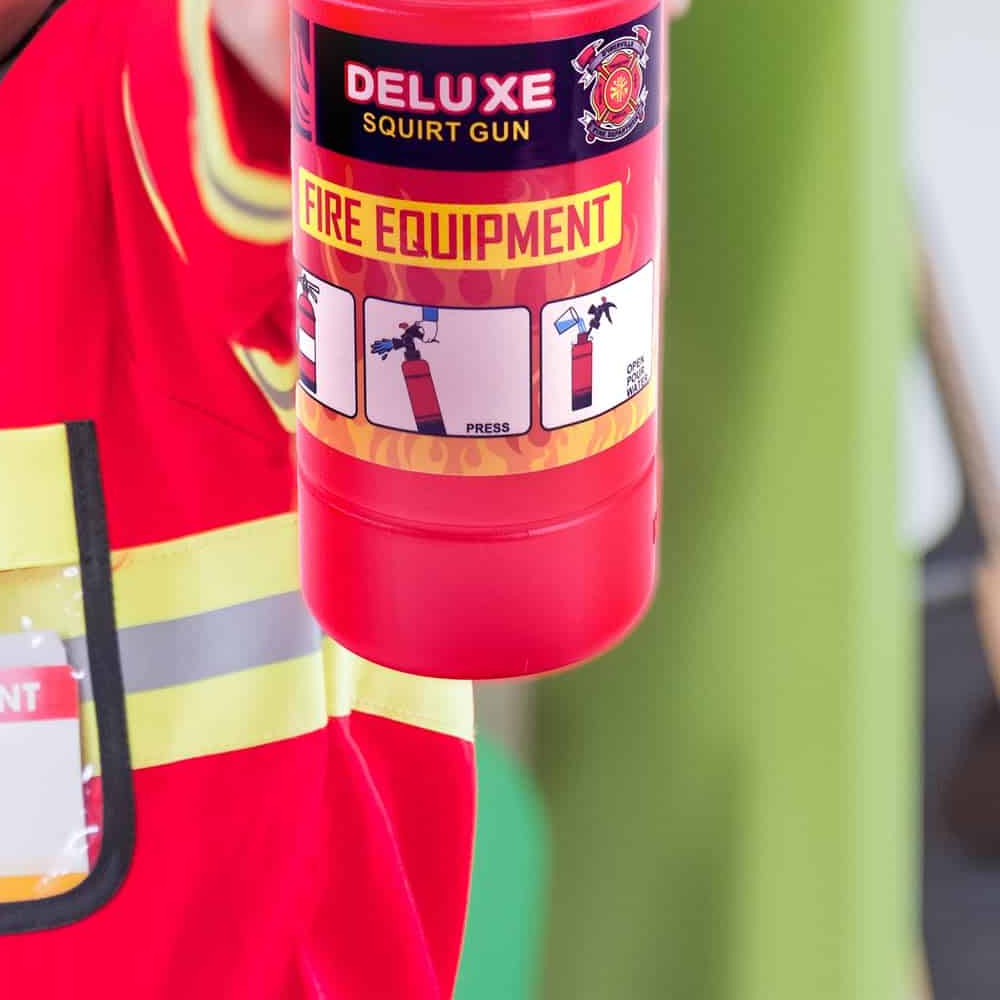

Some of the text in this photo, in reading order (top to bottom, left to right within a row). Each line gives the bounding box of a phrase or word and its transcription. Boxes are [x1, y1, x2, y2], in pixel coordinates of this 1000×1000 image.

[346, 62, 554, 112] DELUXE
[362, 112, 530, 143] SQUIRT GUN
[304, 180, 610, 261] FIRE EQUIPMENT
[626, 355, 645, 375] OPEN
[466, 422, 510, 434] PRESS
